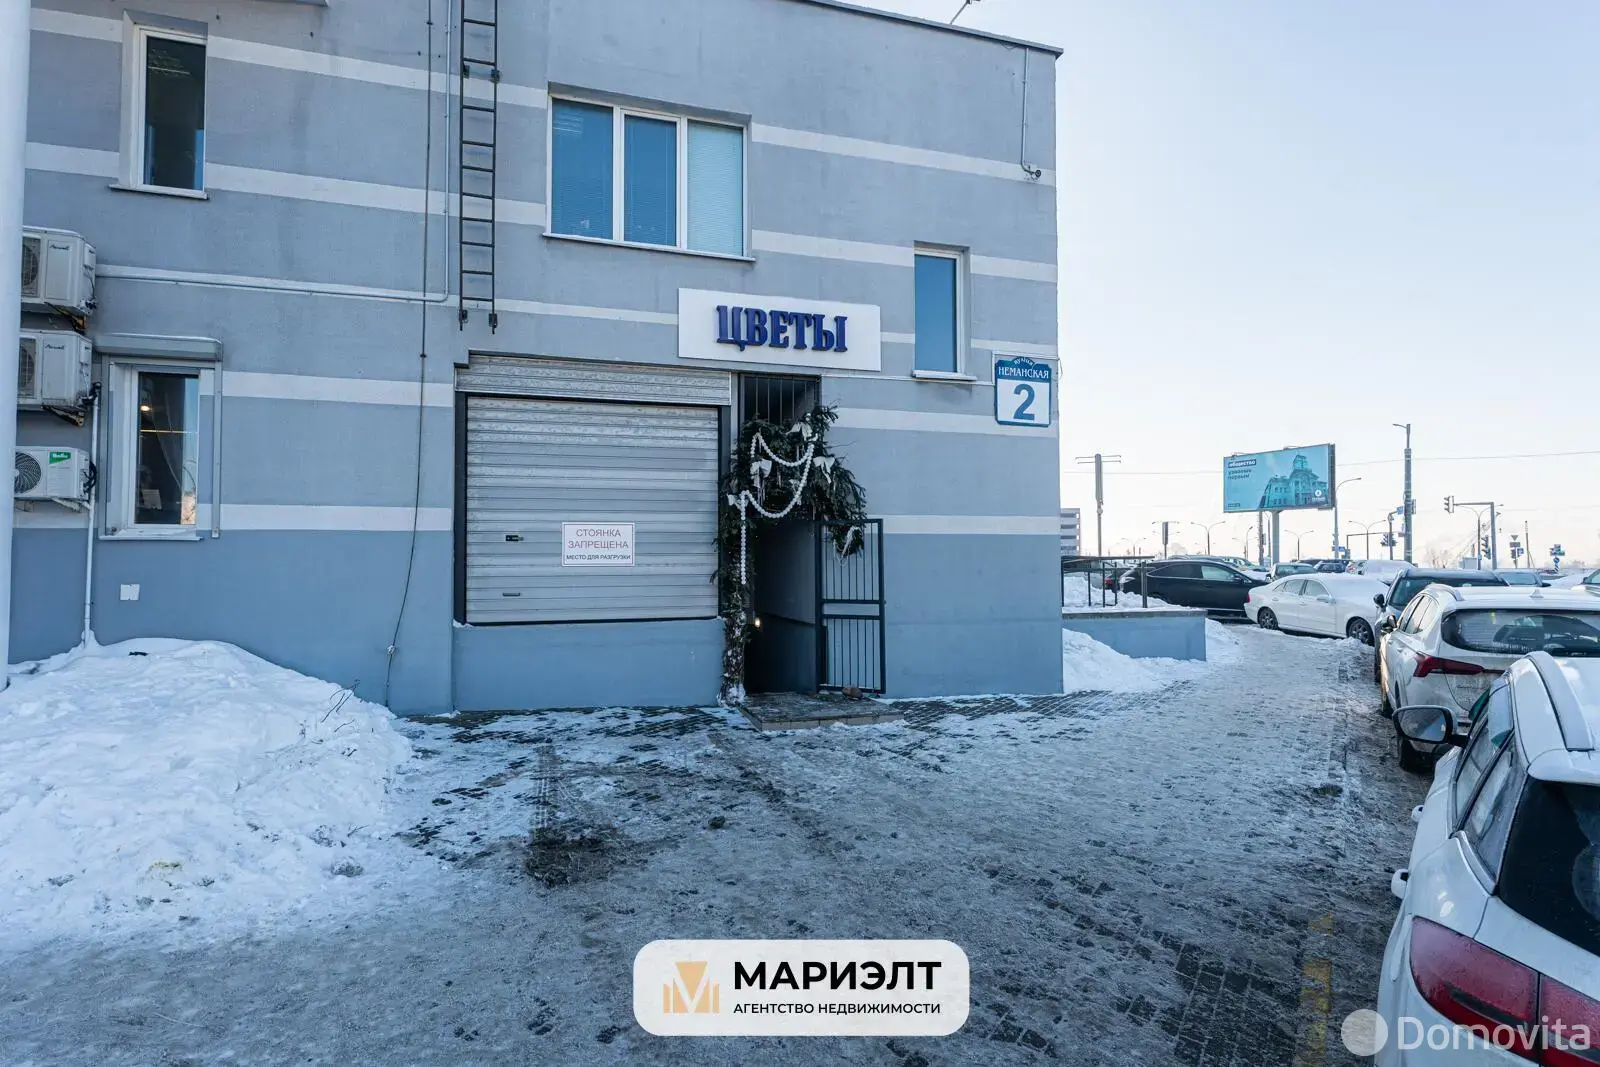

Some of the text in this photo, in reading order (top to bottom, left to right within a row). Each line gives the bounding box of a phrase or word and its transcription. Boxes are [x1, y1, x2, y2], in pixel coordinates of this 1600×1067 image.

[716, 305, 848, 352] ЦВЕТЫ
[1013, 384, 1035, 420] 2
[576, 529, 621, 537] СТОЯНКА
[568, 540, 629, 550] ЗАПРЕЩЕНА
